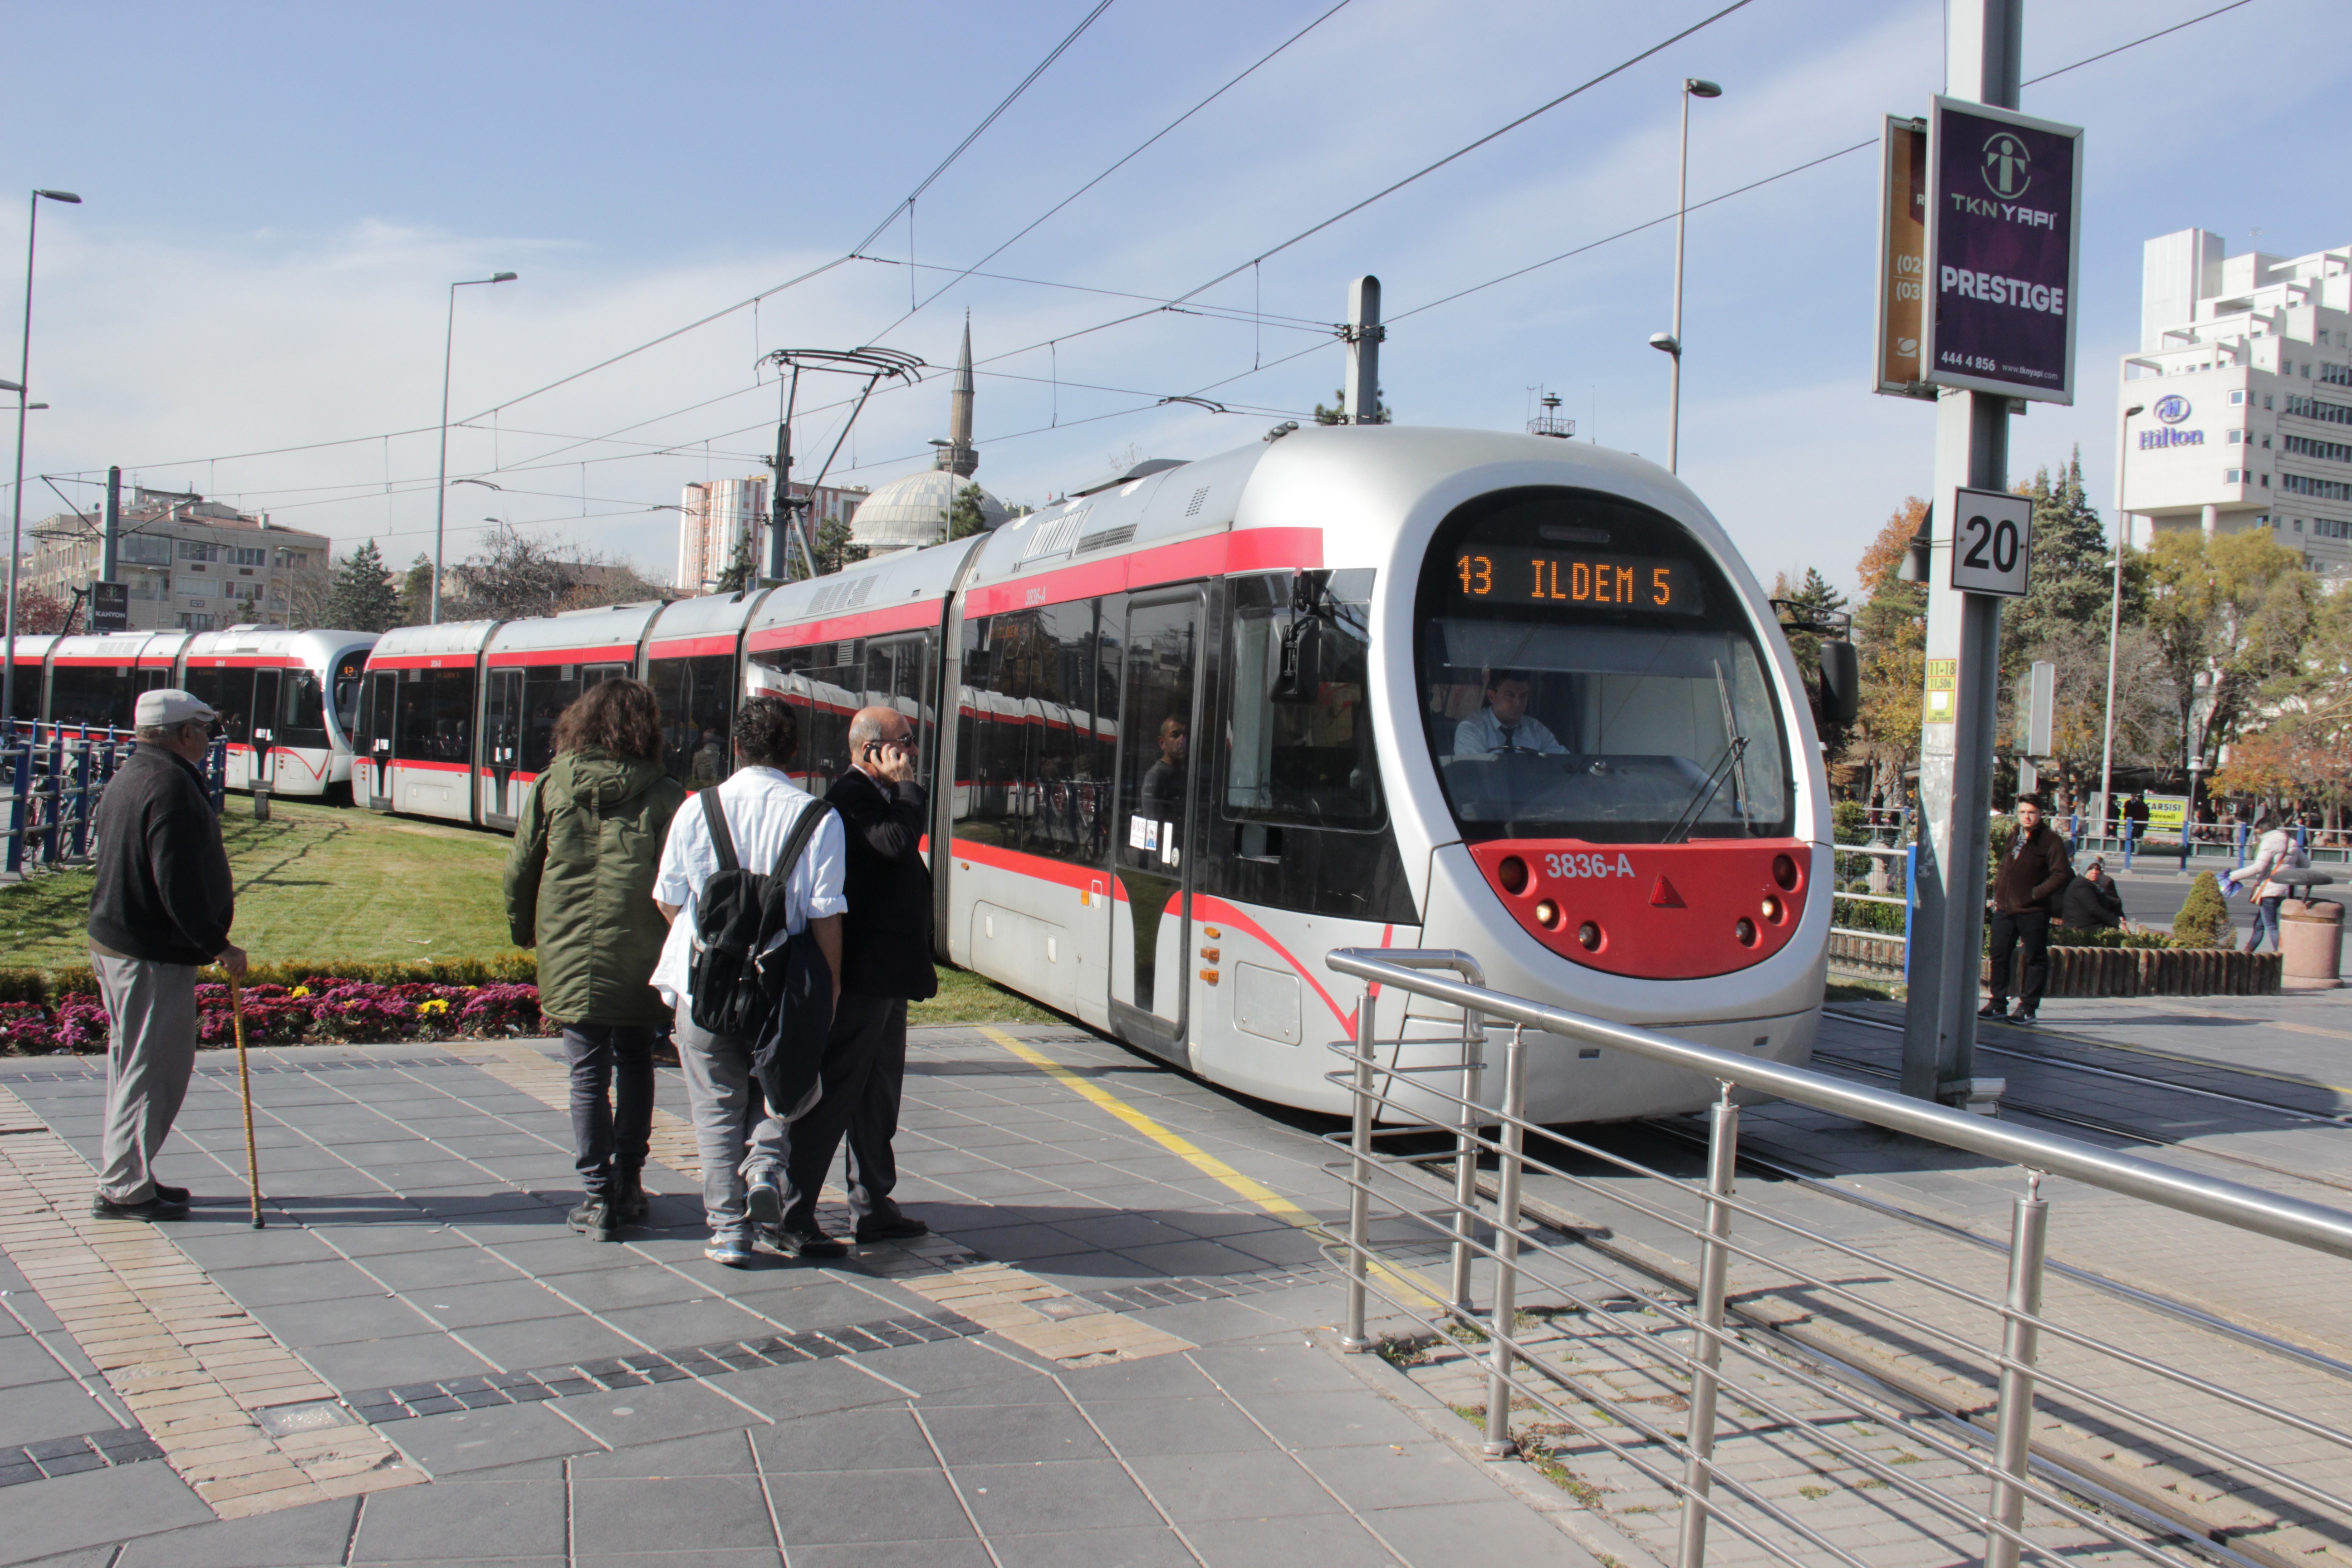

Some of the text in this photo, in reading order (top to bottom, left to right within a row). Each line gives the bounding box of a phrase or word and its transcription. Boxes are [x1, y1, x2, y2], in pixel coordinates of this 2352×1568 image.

[1897, 254, 1924, 274] (02
[1896, 282, 1923, 301] (03
[1941, 265, 2064, 314] PRESTIGE
[1941, 351, 2058, 380] 444 4 856 www.tknyapi.com
[2138, 426, 2204, 450] Hilton
[1963, 515, 2019, 573] 20
[1531, 559, 1634, 603] ILDEM
[1653, 568, 1670, 605] 5
[1025, 586, 1046, 606] 3836-A
[95, 610, 126, 618] KANYON
[1930, 662, 1955, 676] 11-18
[1931, 678, 1951, 690] 11,506
[1545, 853, 1635, 878] 3836-A
